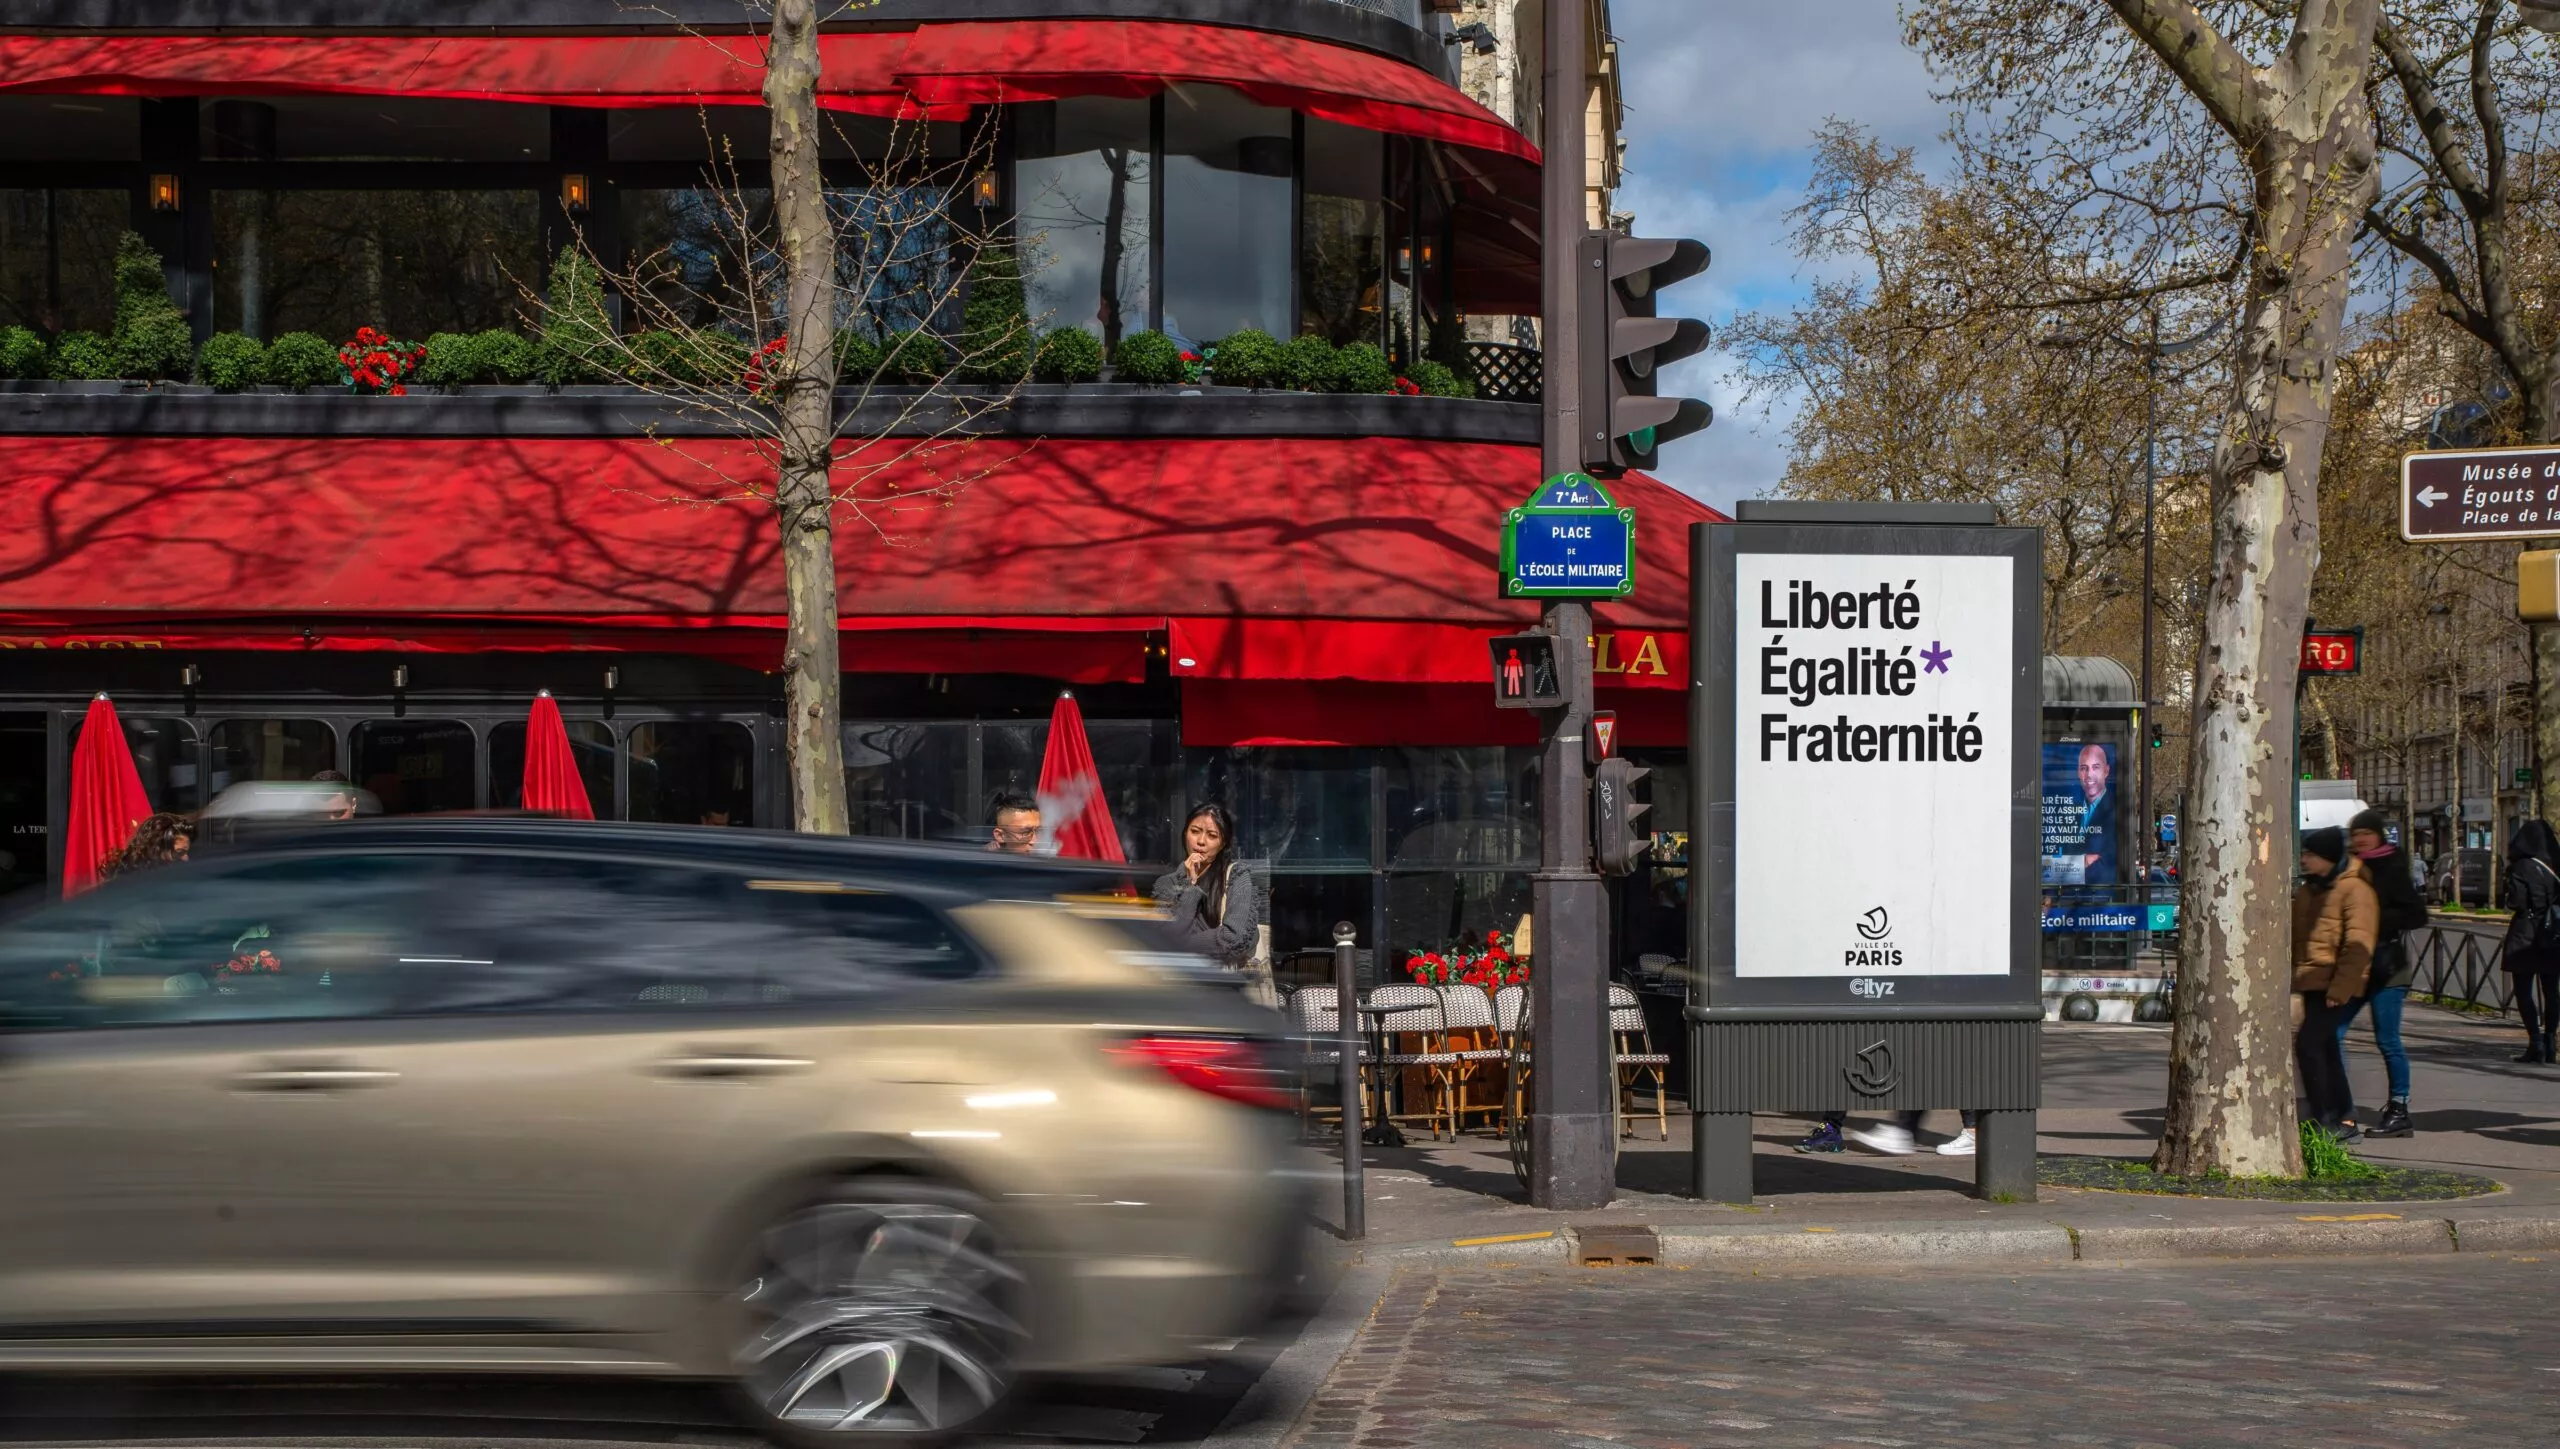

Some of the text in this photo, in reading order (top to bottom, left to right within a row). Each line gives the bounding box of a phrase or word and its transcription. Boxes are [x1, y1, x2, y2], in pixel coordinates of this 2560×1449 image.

[2463, 461, 2560, 481] Musée d
[2463, 485, 2535, 508] Égouts
[2463, 511, 2509, 525] Place
[2519, 509, 2538, 522] de
[1552, 526, 1592, 539] PLACE
[1520, 561, 1623, 577] L'ÉCOLE MILITAIRE
[1761, 579, 1920, 630] Liberté
[1593, 633, 1669, 675] LA
[2306, 642, 2346, 665] RO
[1761, 712, 1983, 762] Fraternité
[2042, 796, 2053, 804] UR
[2041, 806, 2056, 814] EUX
[2042, 816, 2053, 824] NS
[2055, 816, 2064, 824] LE
[13, 825, 26, 834] LA
[2041, 826, 2103, 834] EUX VAUT AVOIR
[2045, 835, 2086, 844] ASSUREUR
[2042, 911, 2136, 927] École militaire
[1845, 950, 1903, 966] PARIS
[1850, 978, 1895, 999] Cityz
